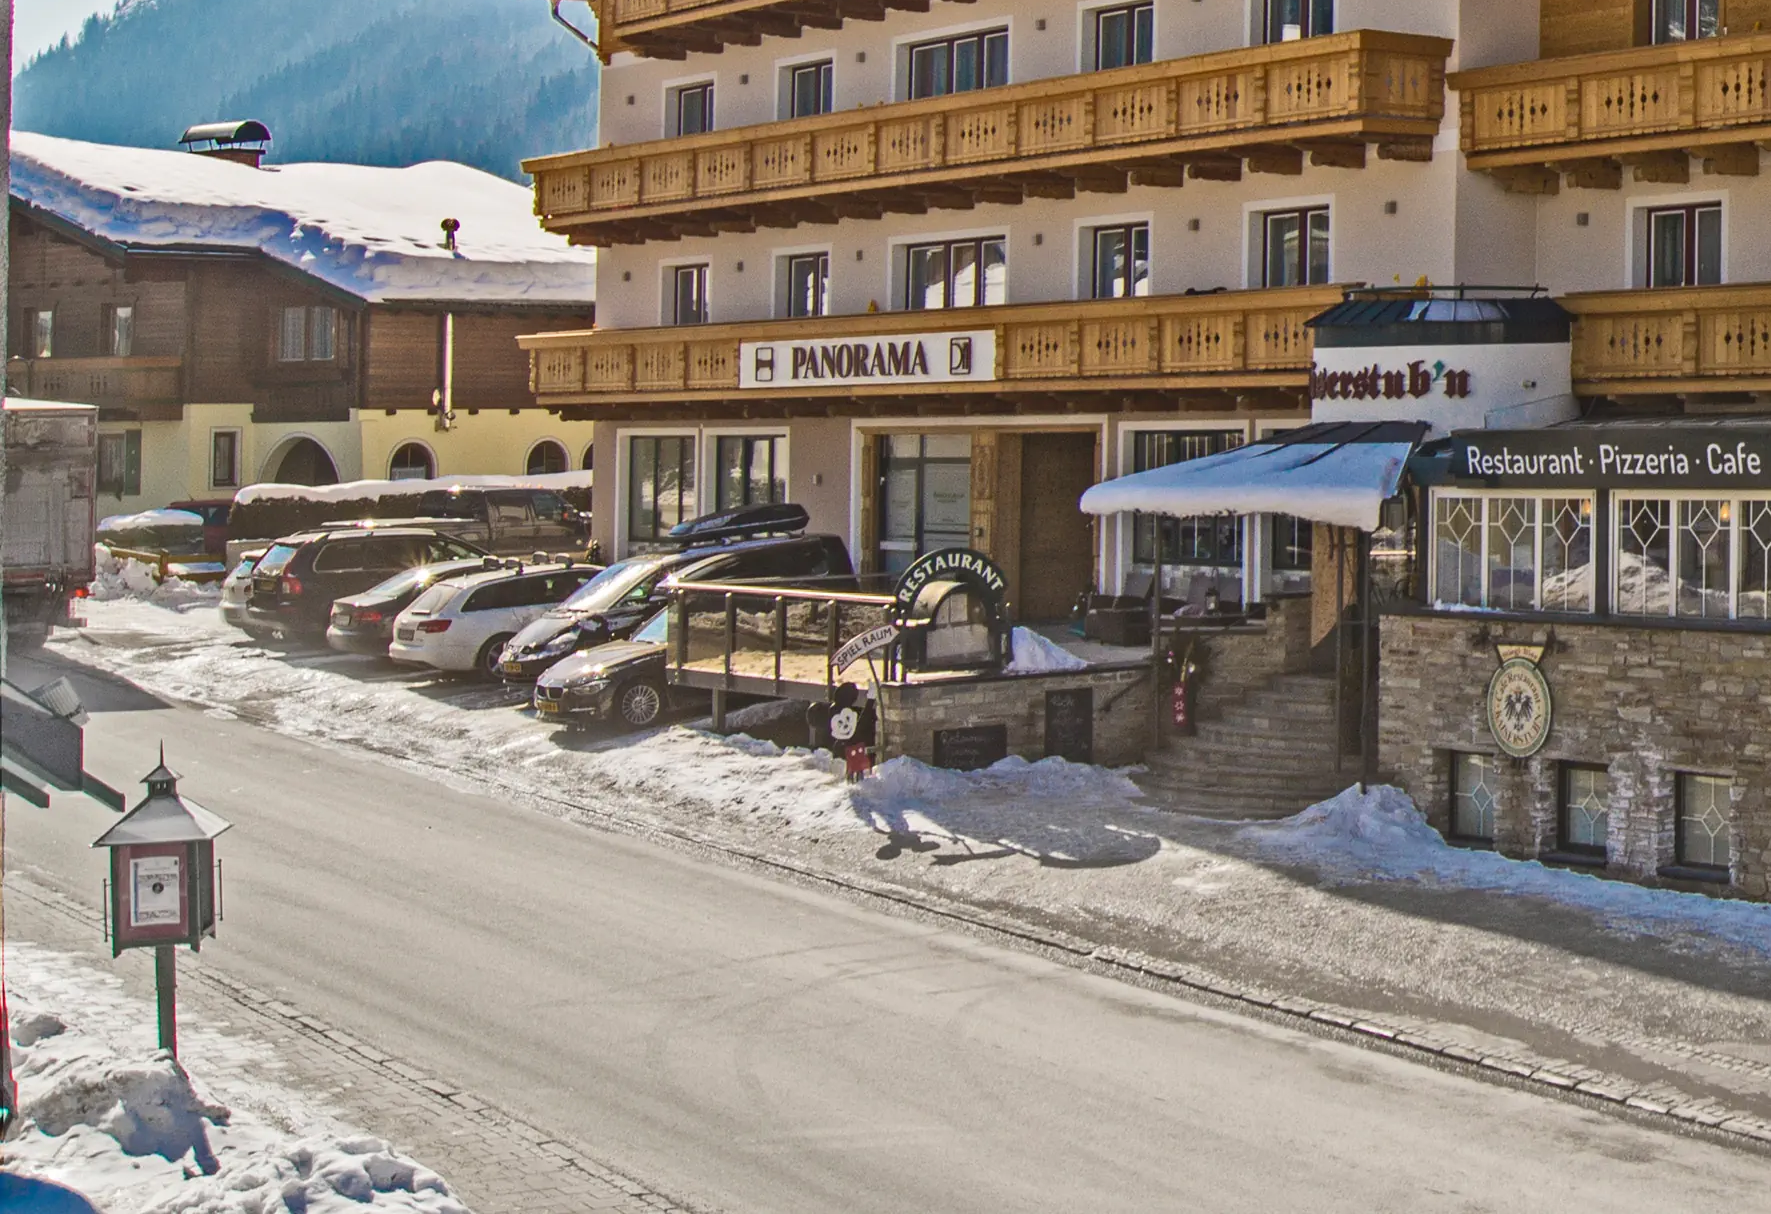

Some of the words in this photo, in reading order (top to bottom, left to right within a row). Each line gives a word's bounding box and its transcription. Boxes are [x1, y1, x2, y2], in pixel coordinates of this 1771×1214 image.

[791, 341, 929, 380] PANORAMA
[1466, 445, 1585, 475] Restaurant
[1599, 444, 1690, 475] Pizzeria
[1706, 442, 1762, 475] Cafe
[899, 553, 1004, 603] RESTAURANT
[836, 643, 863, 667] SPIEL
[862, 627, 893, 648] RAUM
